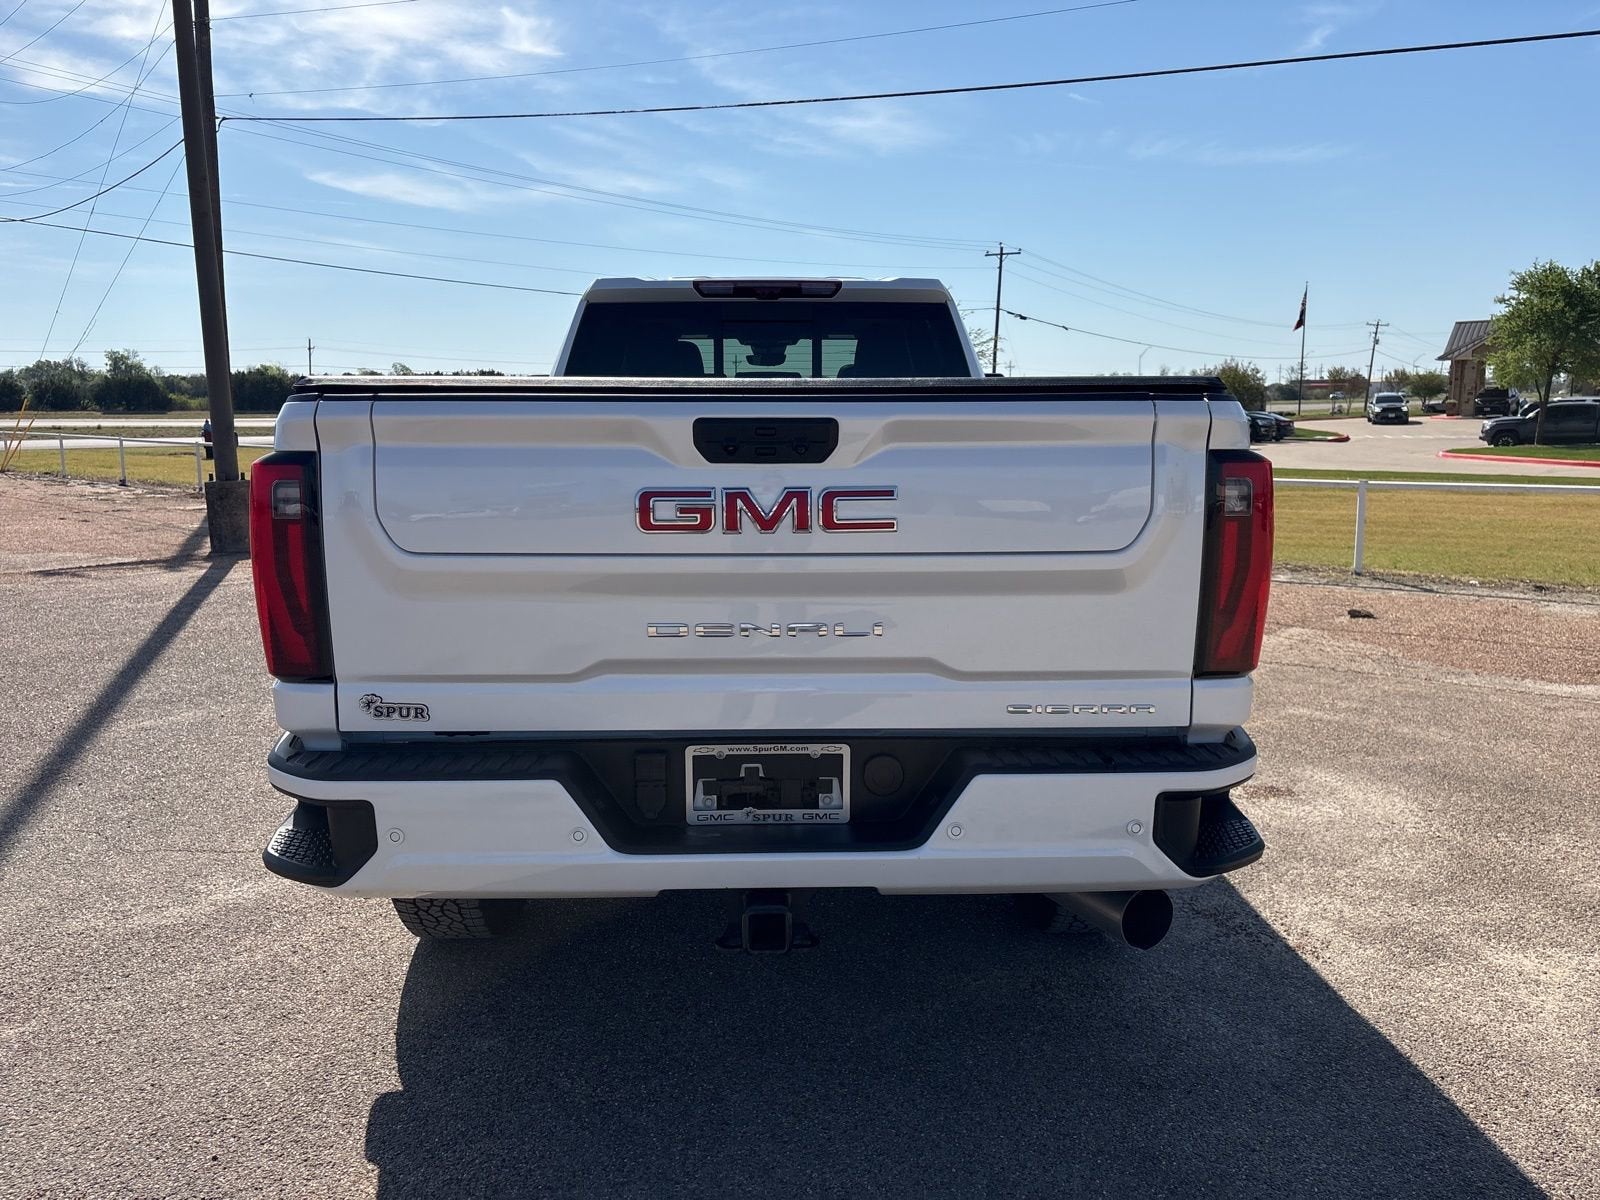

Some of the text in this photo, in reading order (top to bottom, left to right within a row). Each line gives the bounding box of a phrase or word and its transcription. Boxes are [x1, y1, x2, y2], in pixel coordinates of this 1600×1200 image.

[635, 485, 898, 534] GMC
[647, 622, 883, 637] DENALI
[374, 705, 426, 719] SPUR
[1006, 704, 1156, 714] SIERRA
[727, 745, 809, 753] www.SpurGM.com
[696, 812, 840, 822] GMC SPUR GMC
